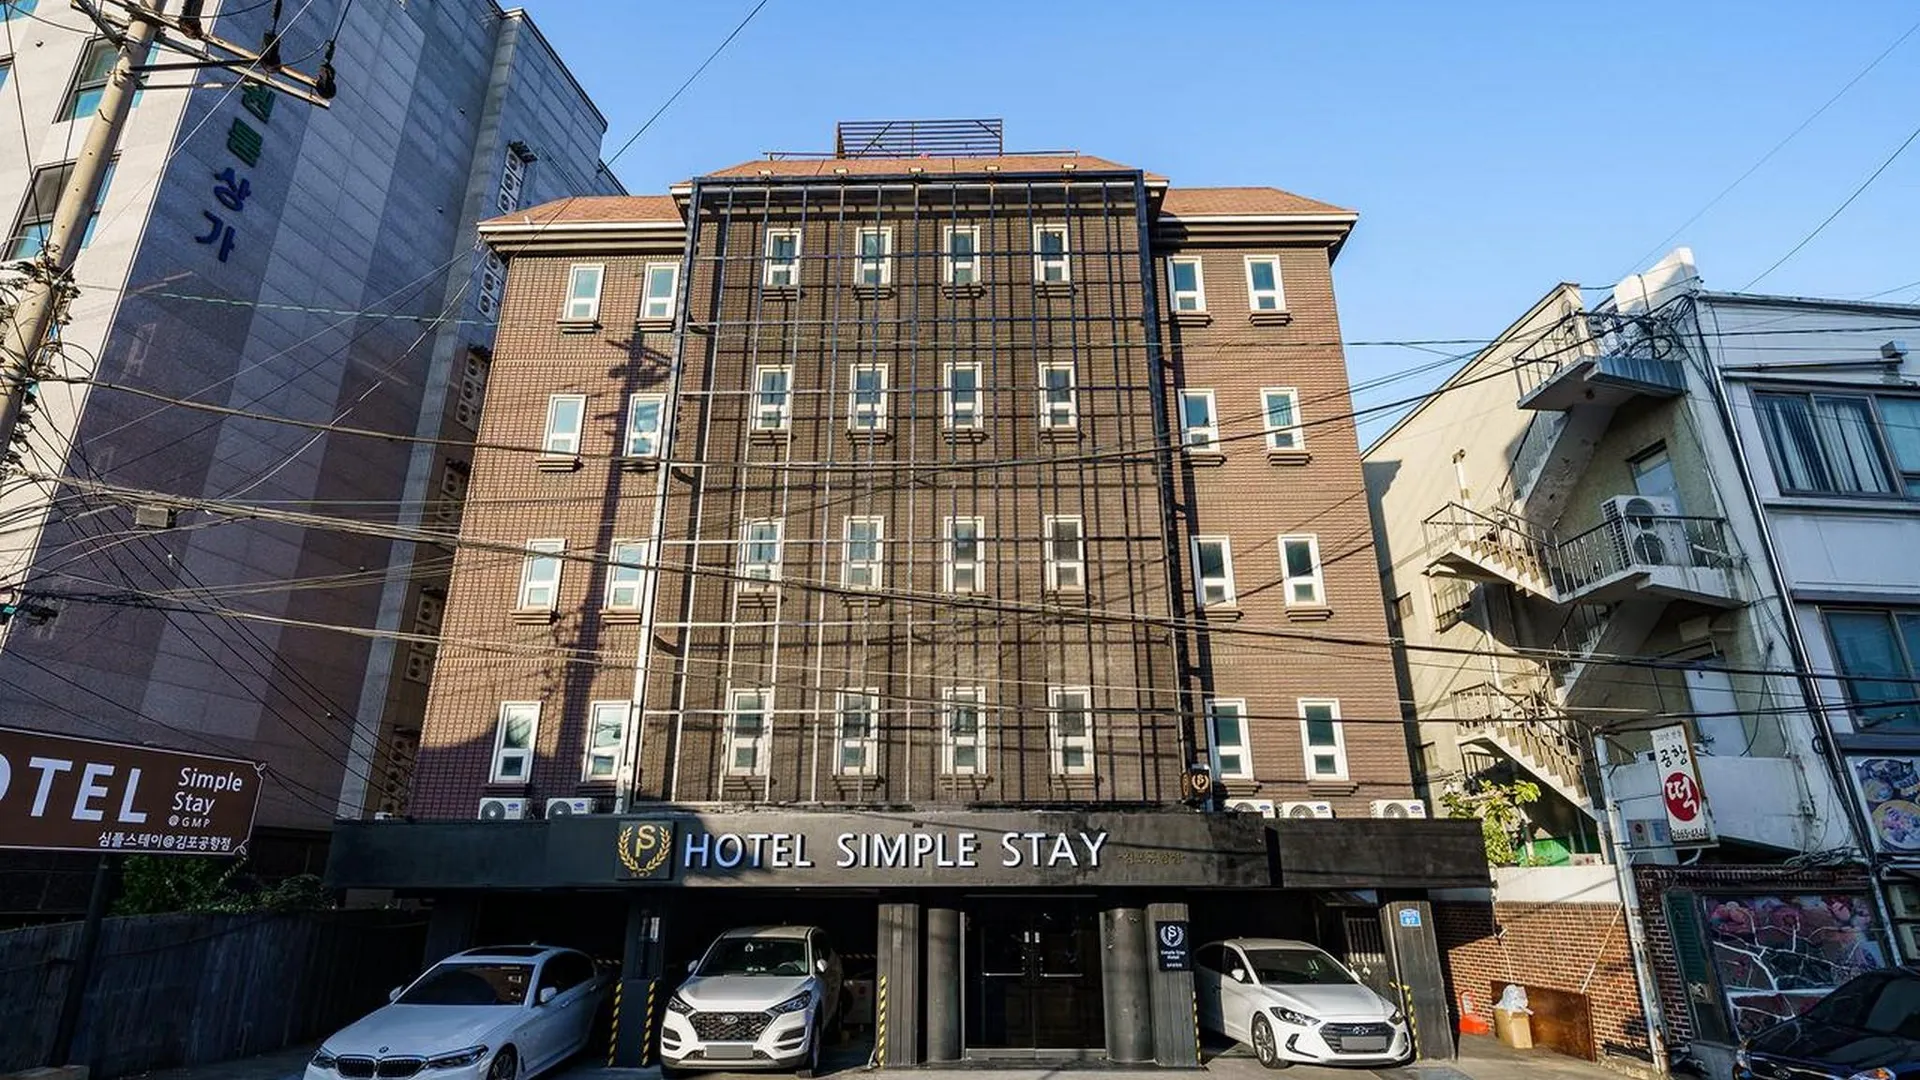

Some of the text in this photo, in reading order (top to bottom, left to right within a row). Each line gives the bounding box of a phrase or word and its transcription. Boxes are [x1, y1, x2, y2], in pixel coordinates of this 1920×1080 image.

[1660, 744, 1688, 768] 공항
[0, 754, 147, 824] TEL
[178, 767, 243, 793] Simple
[1666, 776, 1698, 815] 떡
[172, 791, 215, 815] Stay
[684, 832, 1108, 868] HOTEL SIMPLE STAY
